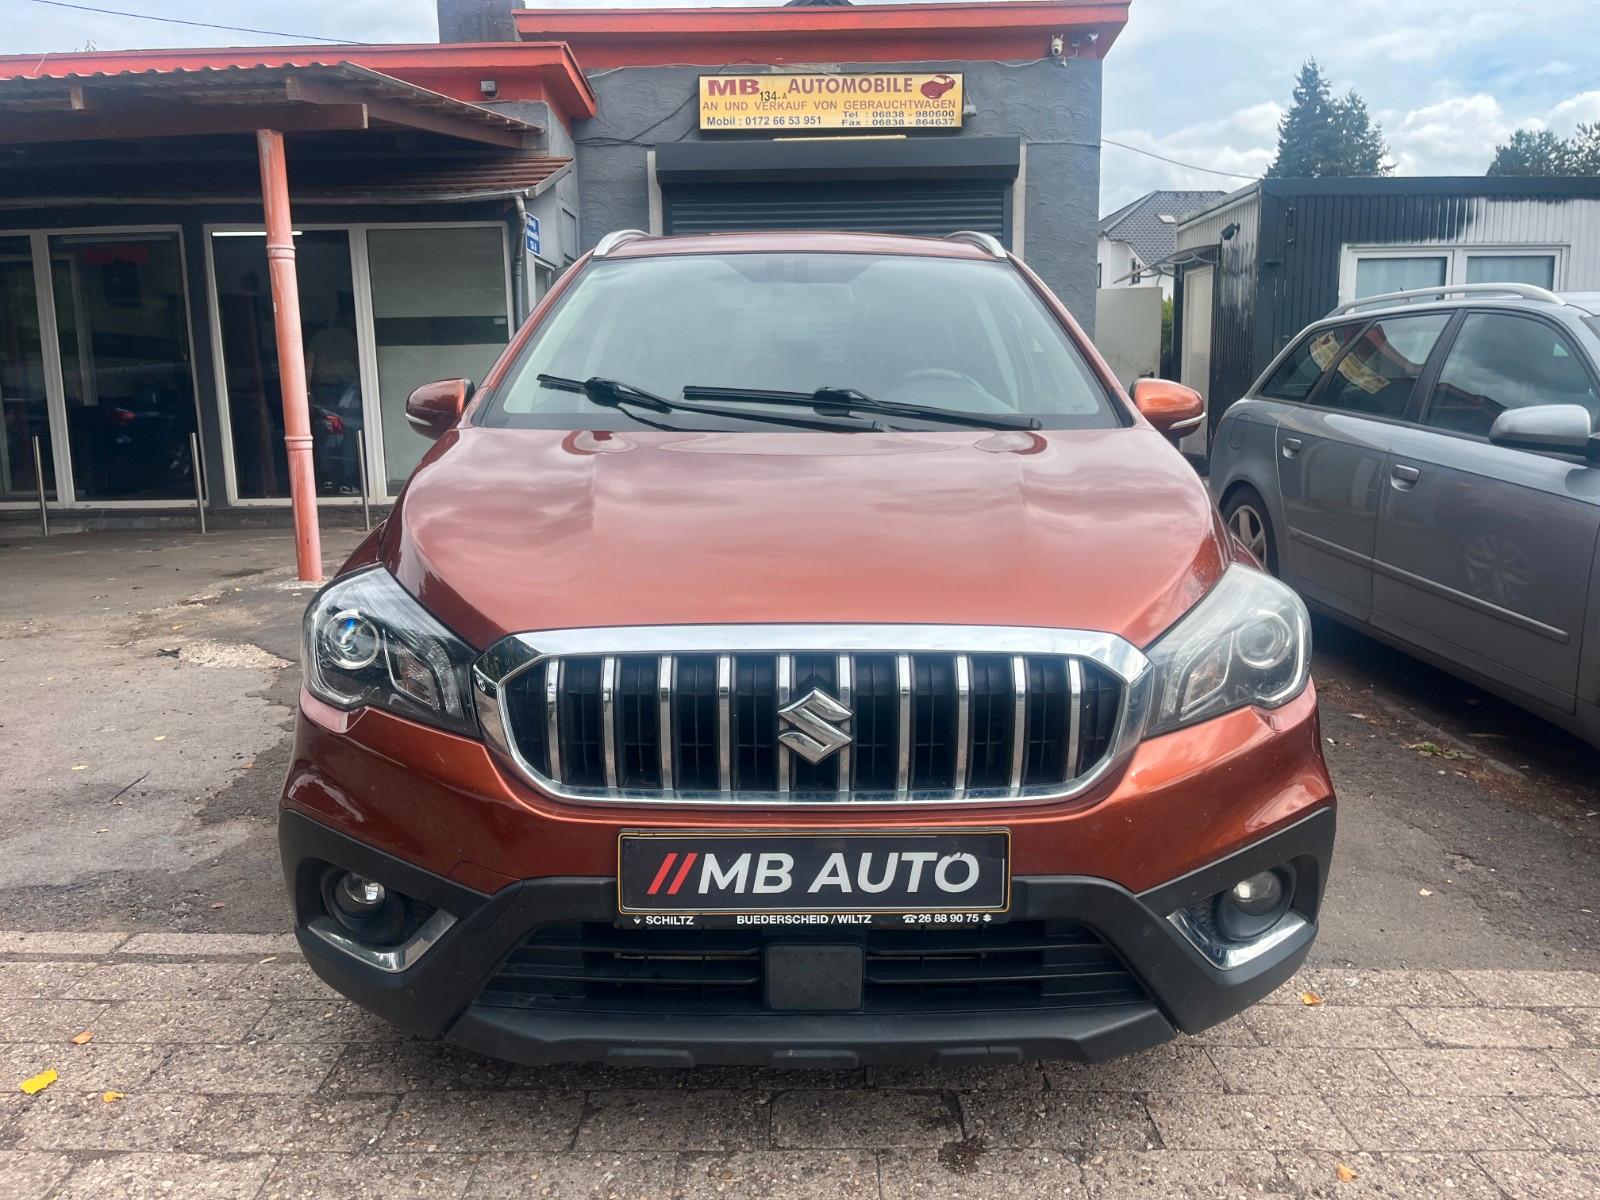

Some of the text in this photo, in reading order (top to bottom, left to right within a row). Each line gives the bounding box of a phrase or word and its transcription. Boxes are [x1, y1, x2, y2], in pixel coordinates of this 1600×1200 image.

[708, 78, 913, 96] MB AUTOMOBILE
[703, 99, 956, 111] AN UND VERKAUF VON GEBRAUCHTWAGEN
[872, 110, 905, 118] 06838
[916, 110, 955, 118] 980600
[707, 116, 736, 126] Mobil
[745, 116, 770, 126] 0172
[773, 116, 785, 125] 66
[788, 115, 800, 125] 53
[803, 115, 821, 125] 951
[872, 118, 905, 126] 06838
[807, 852, 980, 894] AUTO
[645, 915, 695, 926] SCHILTZ
[736, 914, 829, 925] BUEDERSCHEID
[918, 913, 980, 923] 26 88 90 75
